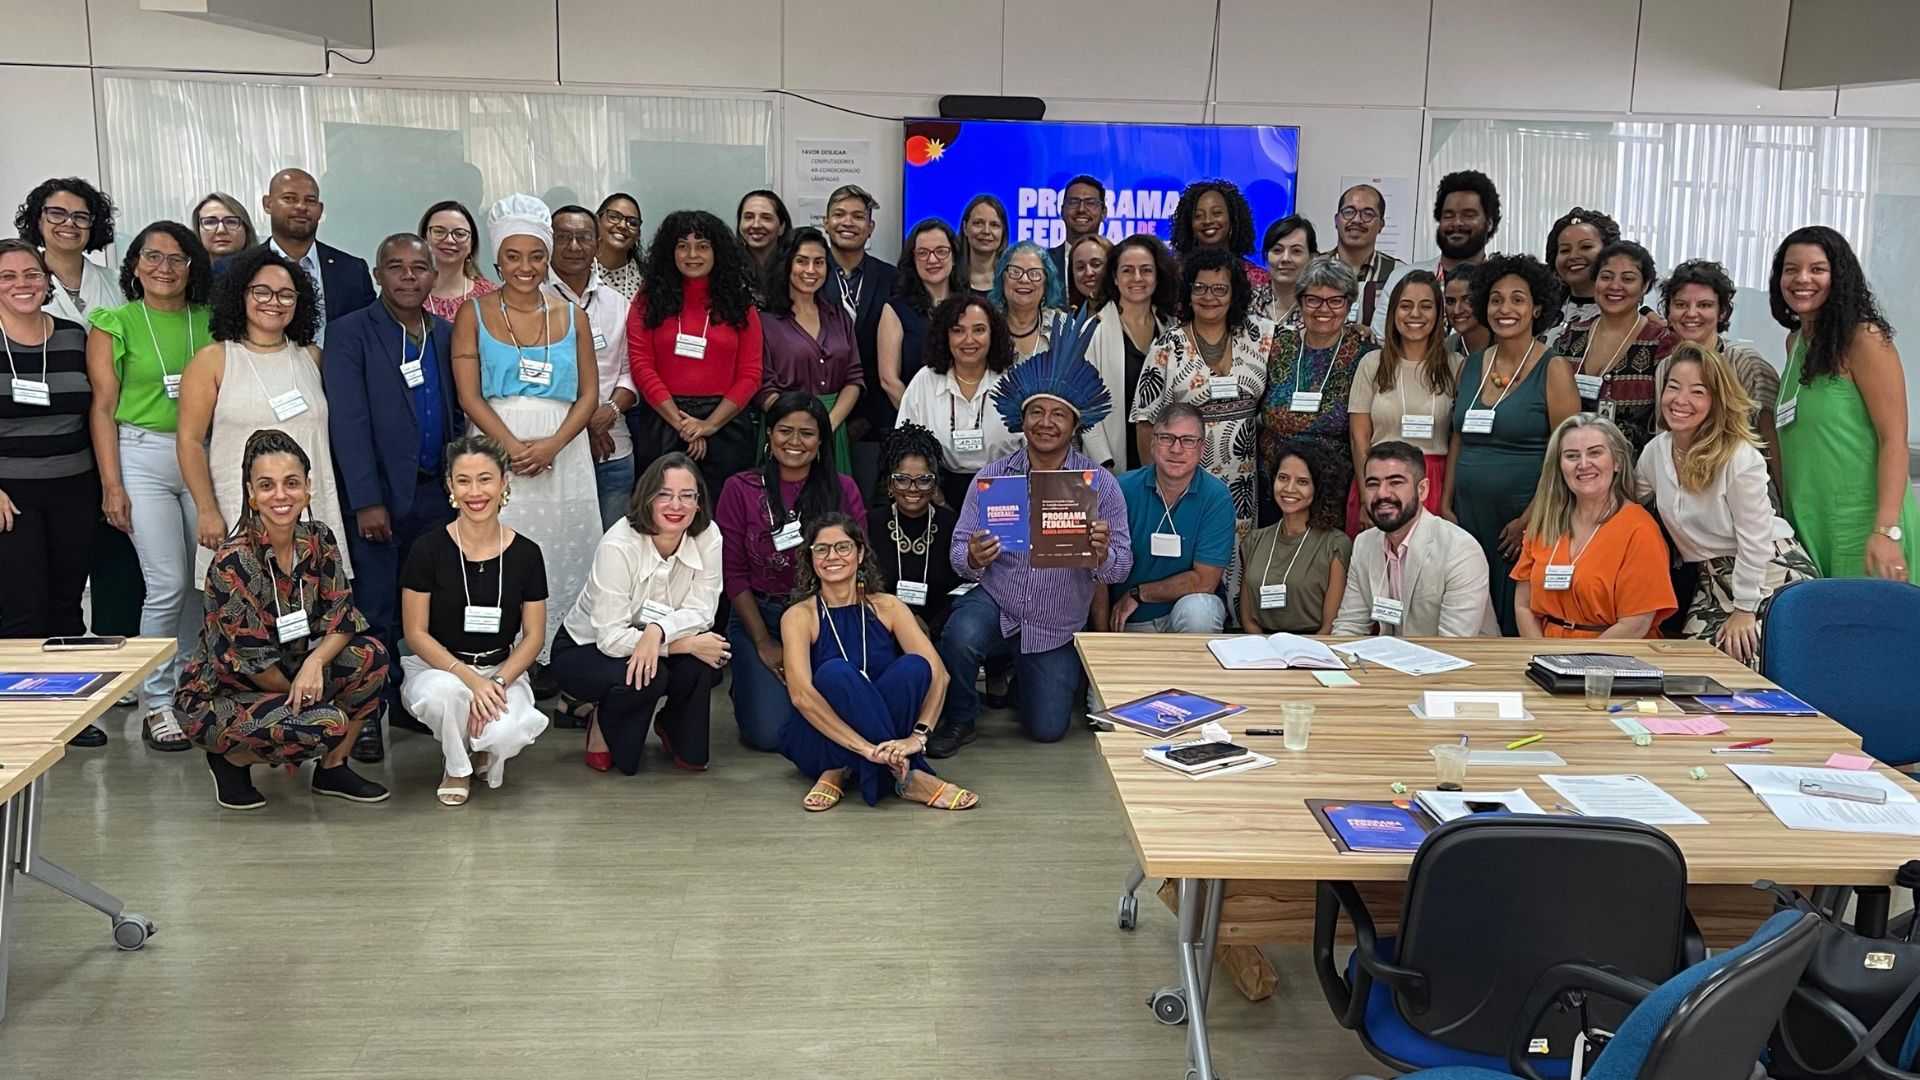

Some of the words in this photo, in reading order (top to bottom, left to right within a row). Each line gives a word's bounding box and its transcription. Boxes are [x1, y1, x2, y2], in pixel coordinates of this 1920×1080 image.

[1136, 220, 1157, 236] DE
[1042, 512, 1087, 520] PROGRAMA
[1042, 520, 1087, 528] FEDERAL
